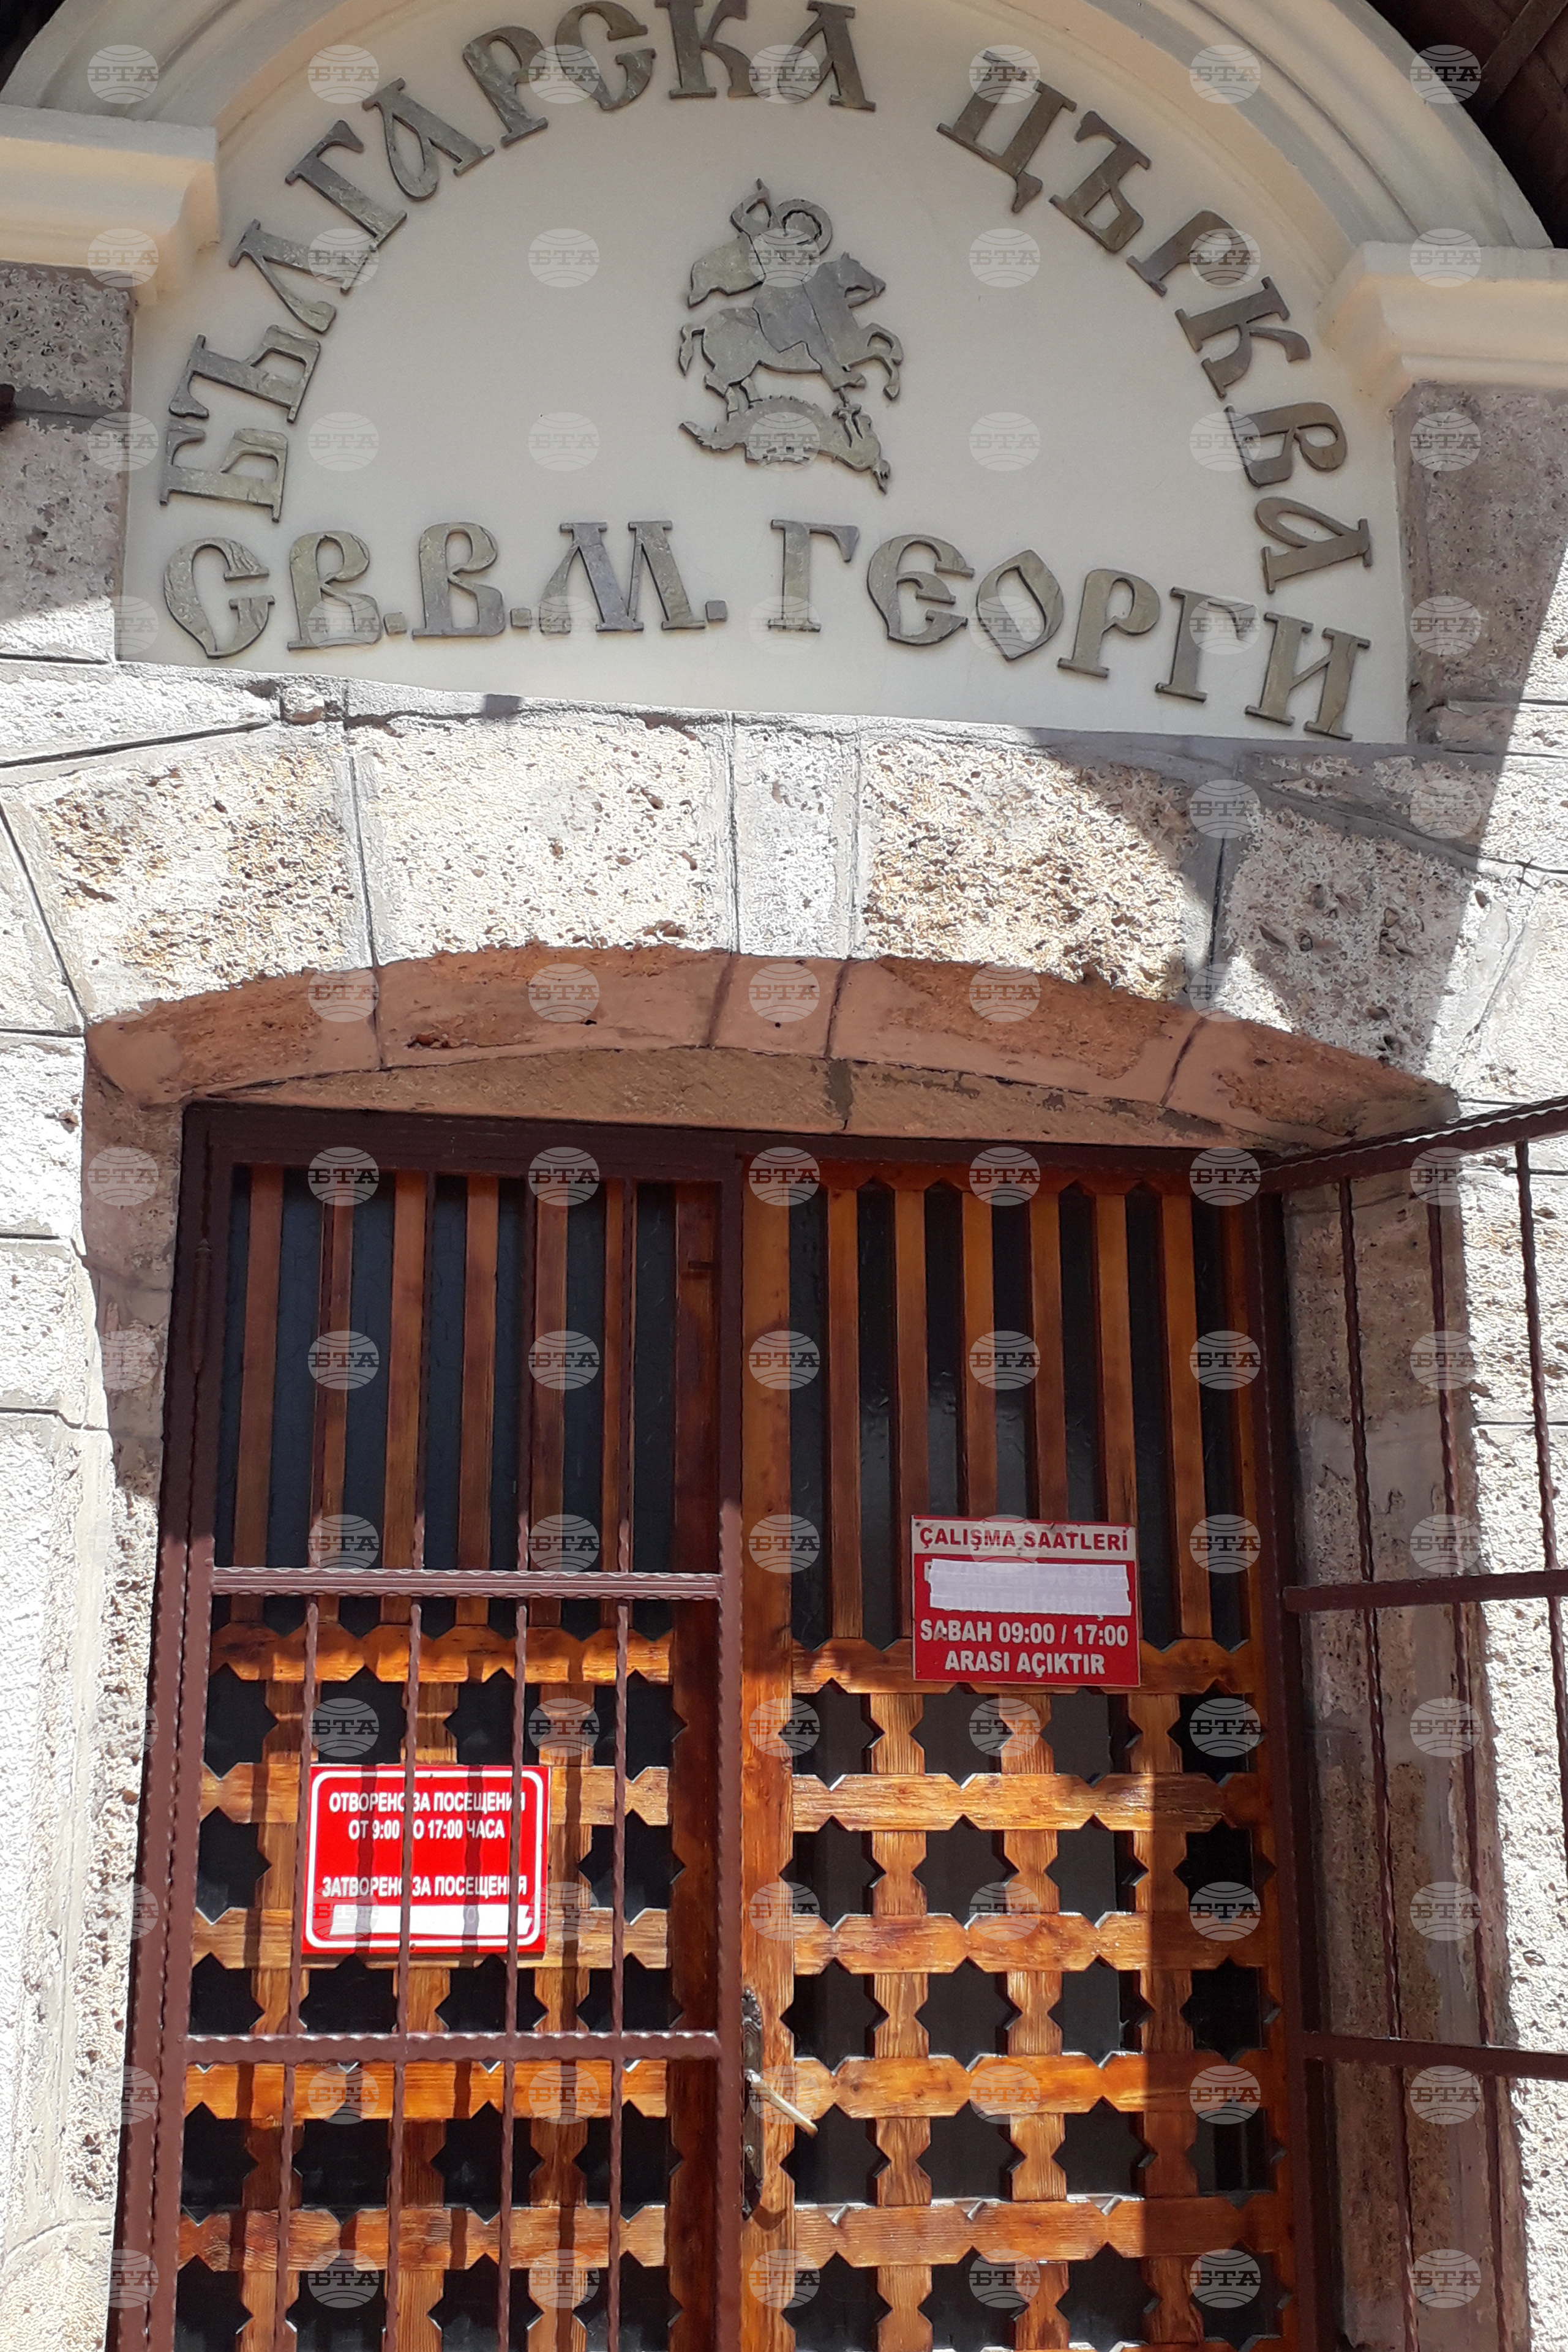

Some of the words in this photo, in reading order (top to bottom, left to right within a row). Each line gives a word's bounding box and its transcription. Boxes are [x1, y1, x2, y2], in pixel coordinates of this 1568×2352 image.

[920, 1527, 1016, 1550] ÇALIŞMA
[1024, 1530, 1128, 1551] SAATLERİ
[920, 1619, 992, 1642] SABAH
[998, 1623, 1055, 1645] 09:00
[1073, 1625, 1128, 1647] 17:00
[945, 1650, 1010, 1672] ARASI
[1016, 1652, 1105, 1678] AÇIKTIR
[413, 1792, 430, 1812] ЗА
[348, 1819, 369, 1839] ОТ
[372, 1819, 400, 1839] 9:00
[428, 1819, 463, 1839] 17:00
[467, 1819, 505, 1839] ЧАСА
[412, 1876, 431, 1896] ЗА
[434, 1876, 527, 1899] ПОСЕЩЕНЯ
